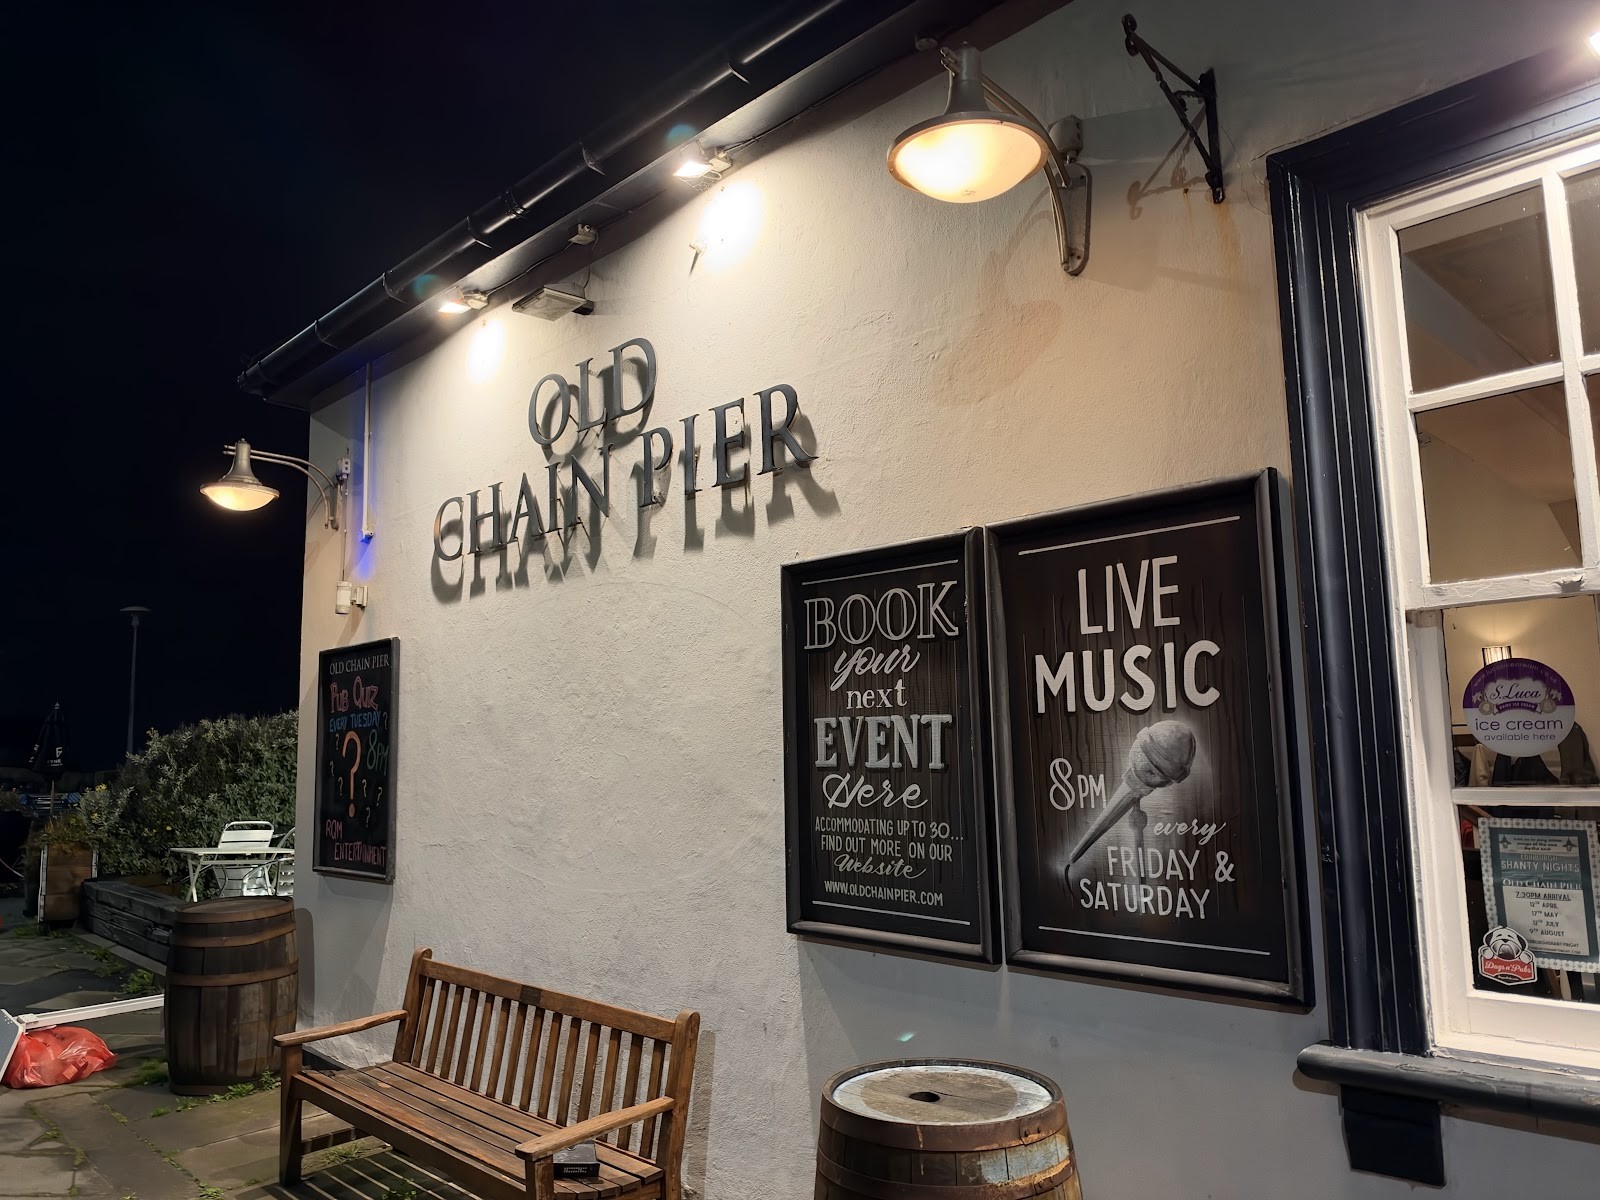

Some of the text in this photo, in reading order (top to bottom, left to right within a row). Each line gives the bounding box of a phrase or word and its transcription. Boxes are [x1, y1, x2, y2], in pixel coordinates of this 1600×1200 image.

[528, 337, 658, 446] OLD
[434, 384, 819, 561] CHAIN PIER
[1078, 555, 1180, 635] LIVE
[803, 580, 959, 650] BOOK
[329, 653, 390, 675] OLD CHAIN PIER
[830, 644, 920, 692] your
[1035, 639, 1221, 714] MUSIC
[846, 679, 908, 710] next
[329, 710, 381, 733] EVERY TUESDAY
[1475, 718, 1563, 731] ice cream
[814, 714, 953, 770] EVENT
[1484, 732, 1556, 741] available here
[822, 773, 928, 809] Here
[1050, 757, 1107, 811] 8PM
[815, 816, 894, 836] ACCOMMODATING
[897, 820, 910, 836] UP
[911, 820, 926, 838] TO
[1153, 819, 1226, 845] every
[821, 834, 953, 862] FIND OUT MORE ON OUR
[834, 854, 927, 879] Website
[1106, 846, 1236, 883] FRIDAY &
[1501, 861, 1580, 873] SHANTY NIGHTS
[824, 880, 944, 907] WWW.OLDCHAINPIER.COM
[1080, 878, 1210, 920] SATURDAY
[1543, 893, 1571, 901] ARRIVAL
[1540, 929, 1565, 937] AUGUST
